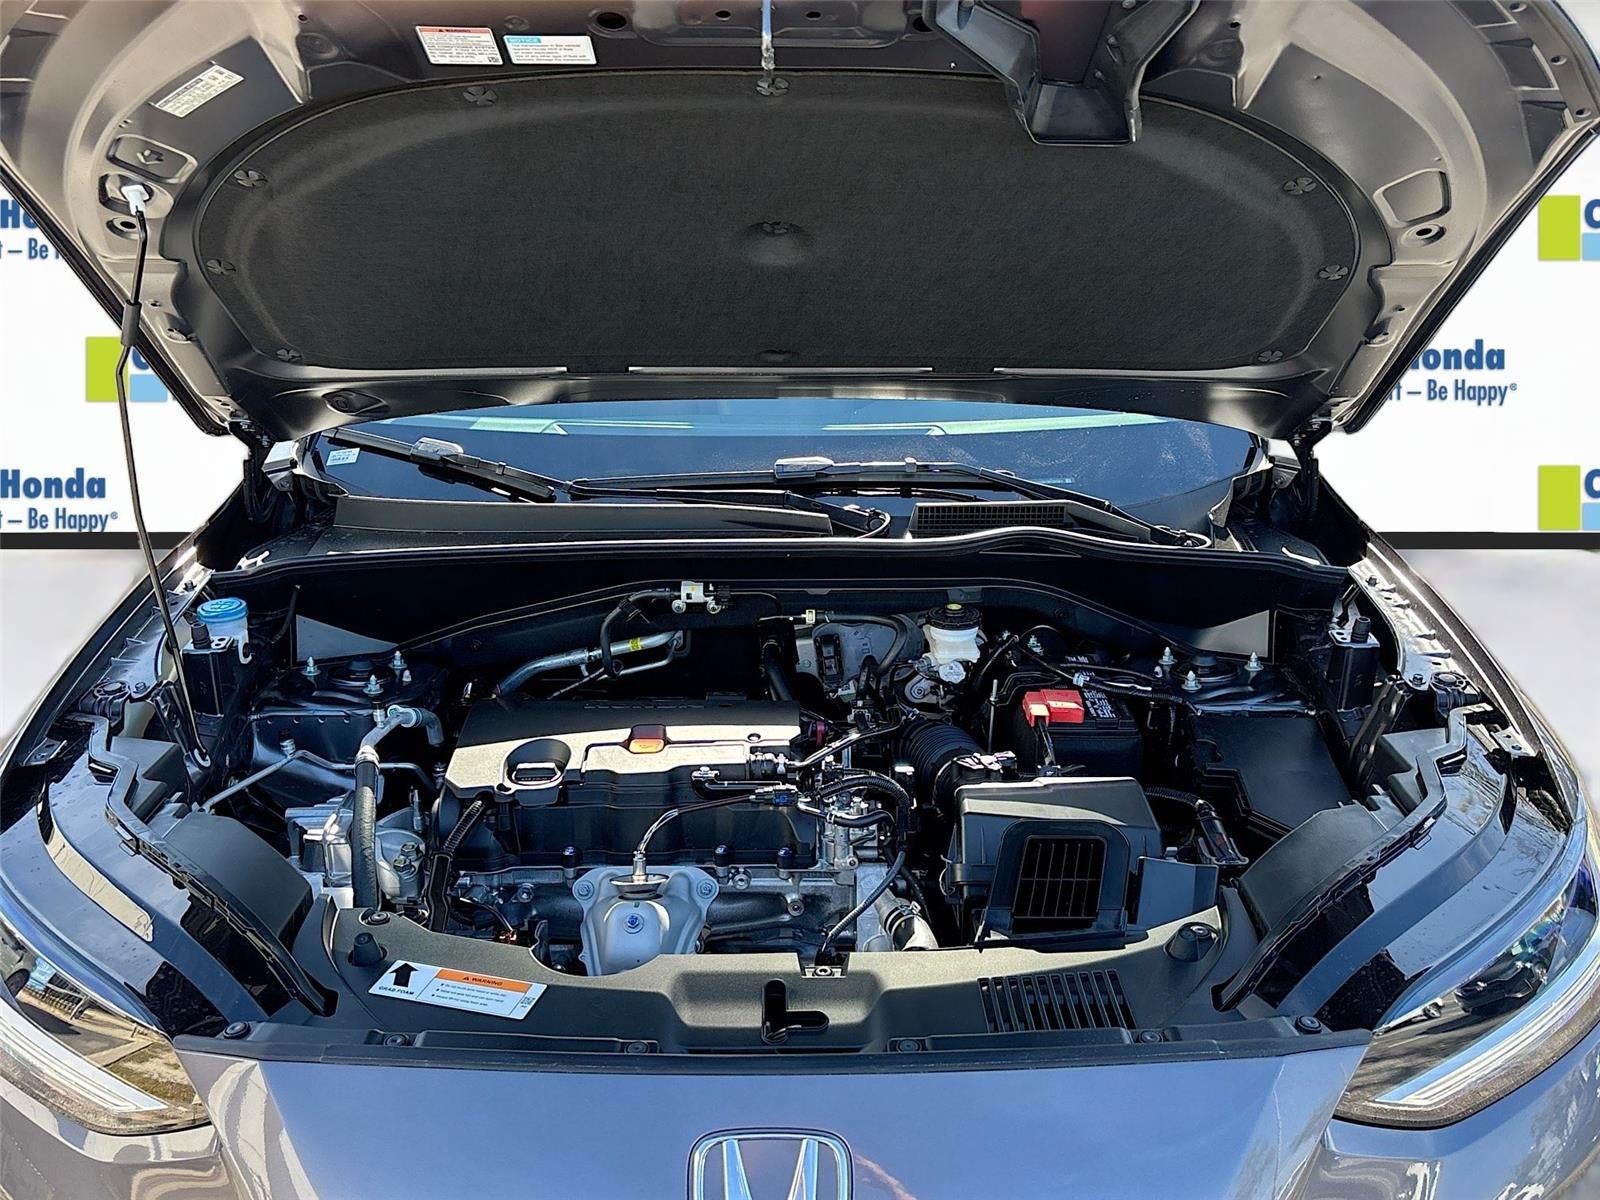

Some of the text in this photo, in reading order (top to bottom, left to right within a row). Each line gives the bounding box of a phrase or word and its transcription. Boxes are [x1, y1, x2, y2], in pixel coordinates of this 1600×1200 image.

[28, 237, 49, 260] Be
[1427, 379, 1448, 401] Be
[0, 467, 106, 498] Honda
[28, 507, 49, 529] Be
[472, 977, 503, 986] WARNING
